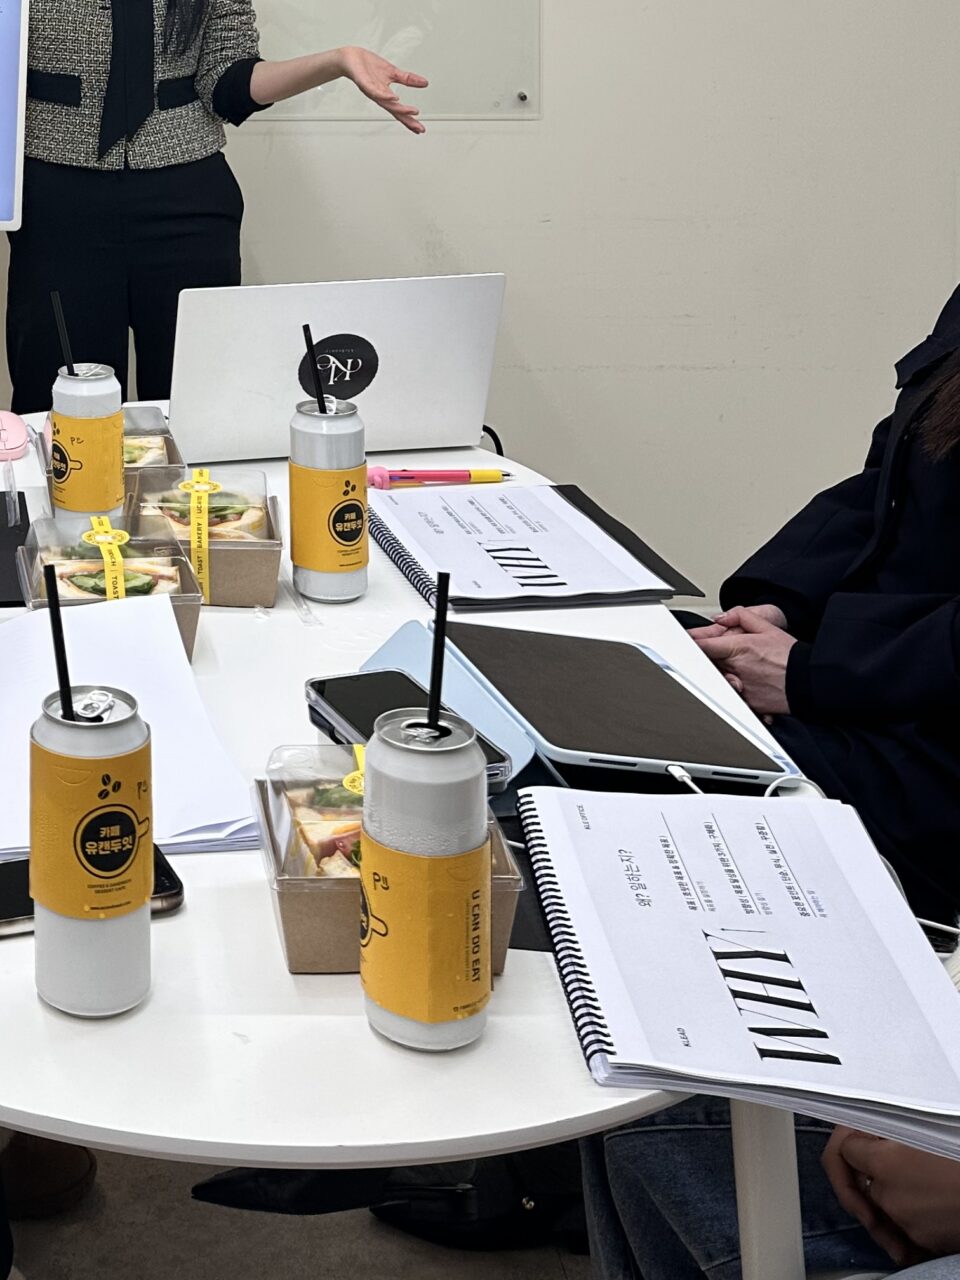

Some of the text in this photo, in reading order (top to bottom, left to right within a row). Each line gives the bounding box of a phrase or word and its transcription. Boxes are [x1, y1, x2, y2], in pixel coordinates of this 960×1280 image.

[196, 555, 204, 575] TOAST
[99, 824, 121, 837] 카페
[85, 835, 133, 855] 유캔두잇
[618, 849, 647, 890] 일하는지?
[471, 889, 481, 983] U CAN DO EAT
[702, 929, 842, 1066] WHY
[676, 1027, 692, 1048] KLEAD
